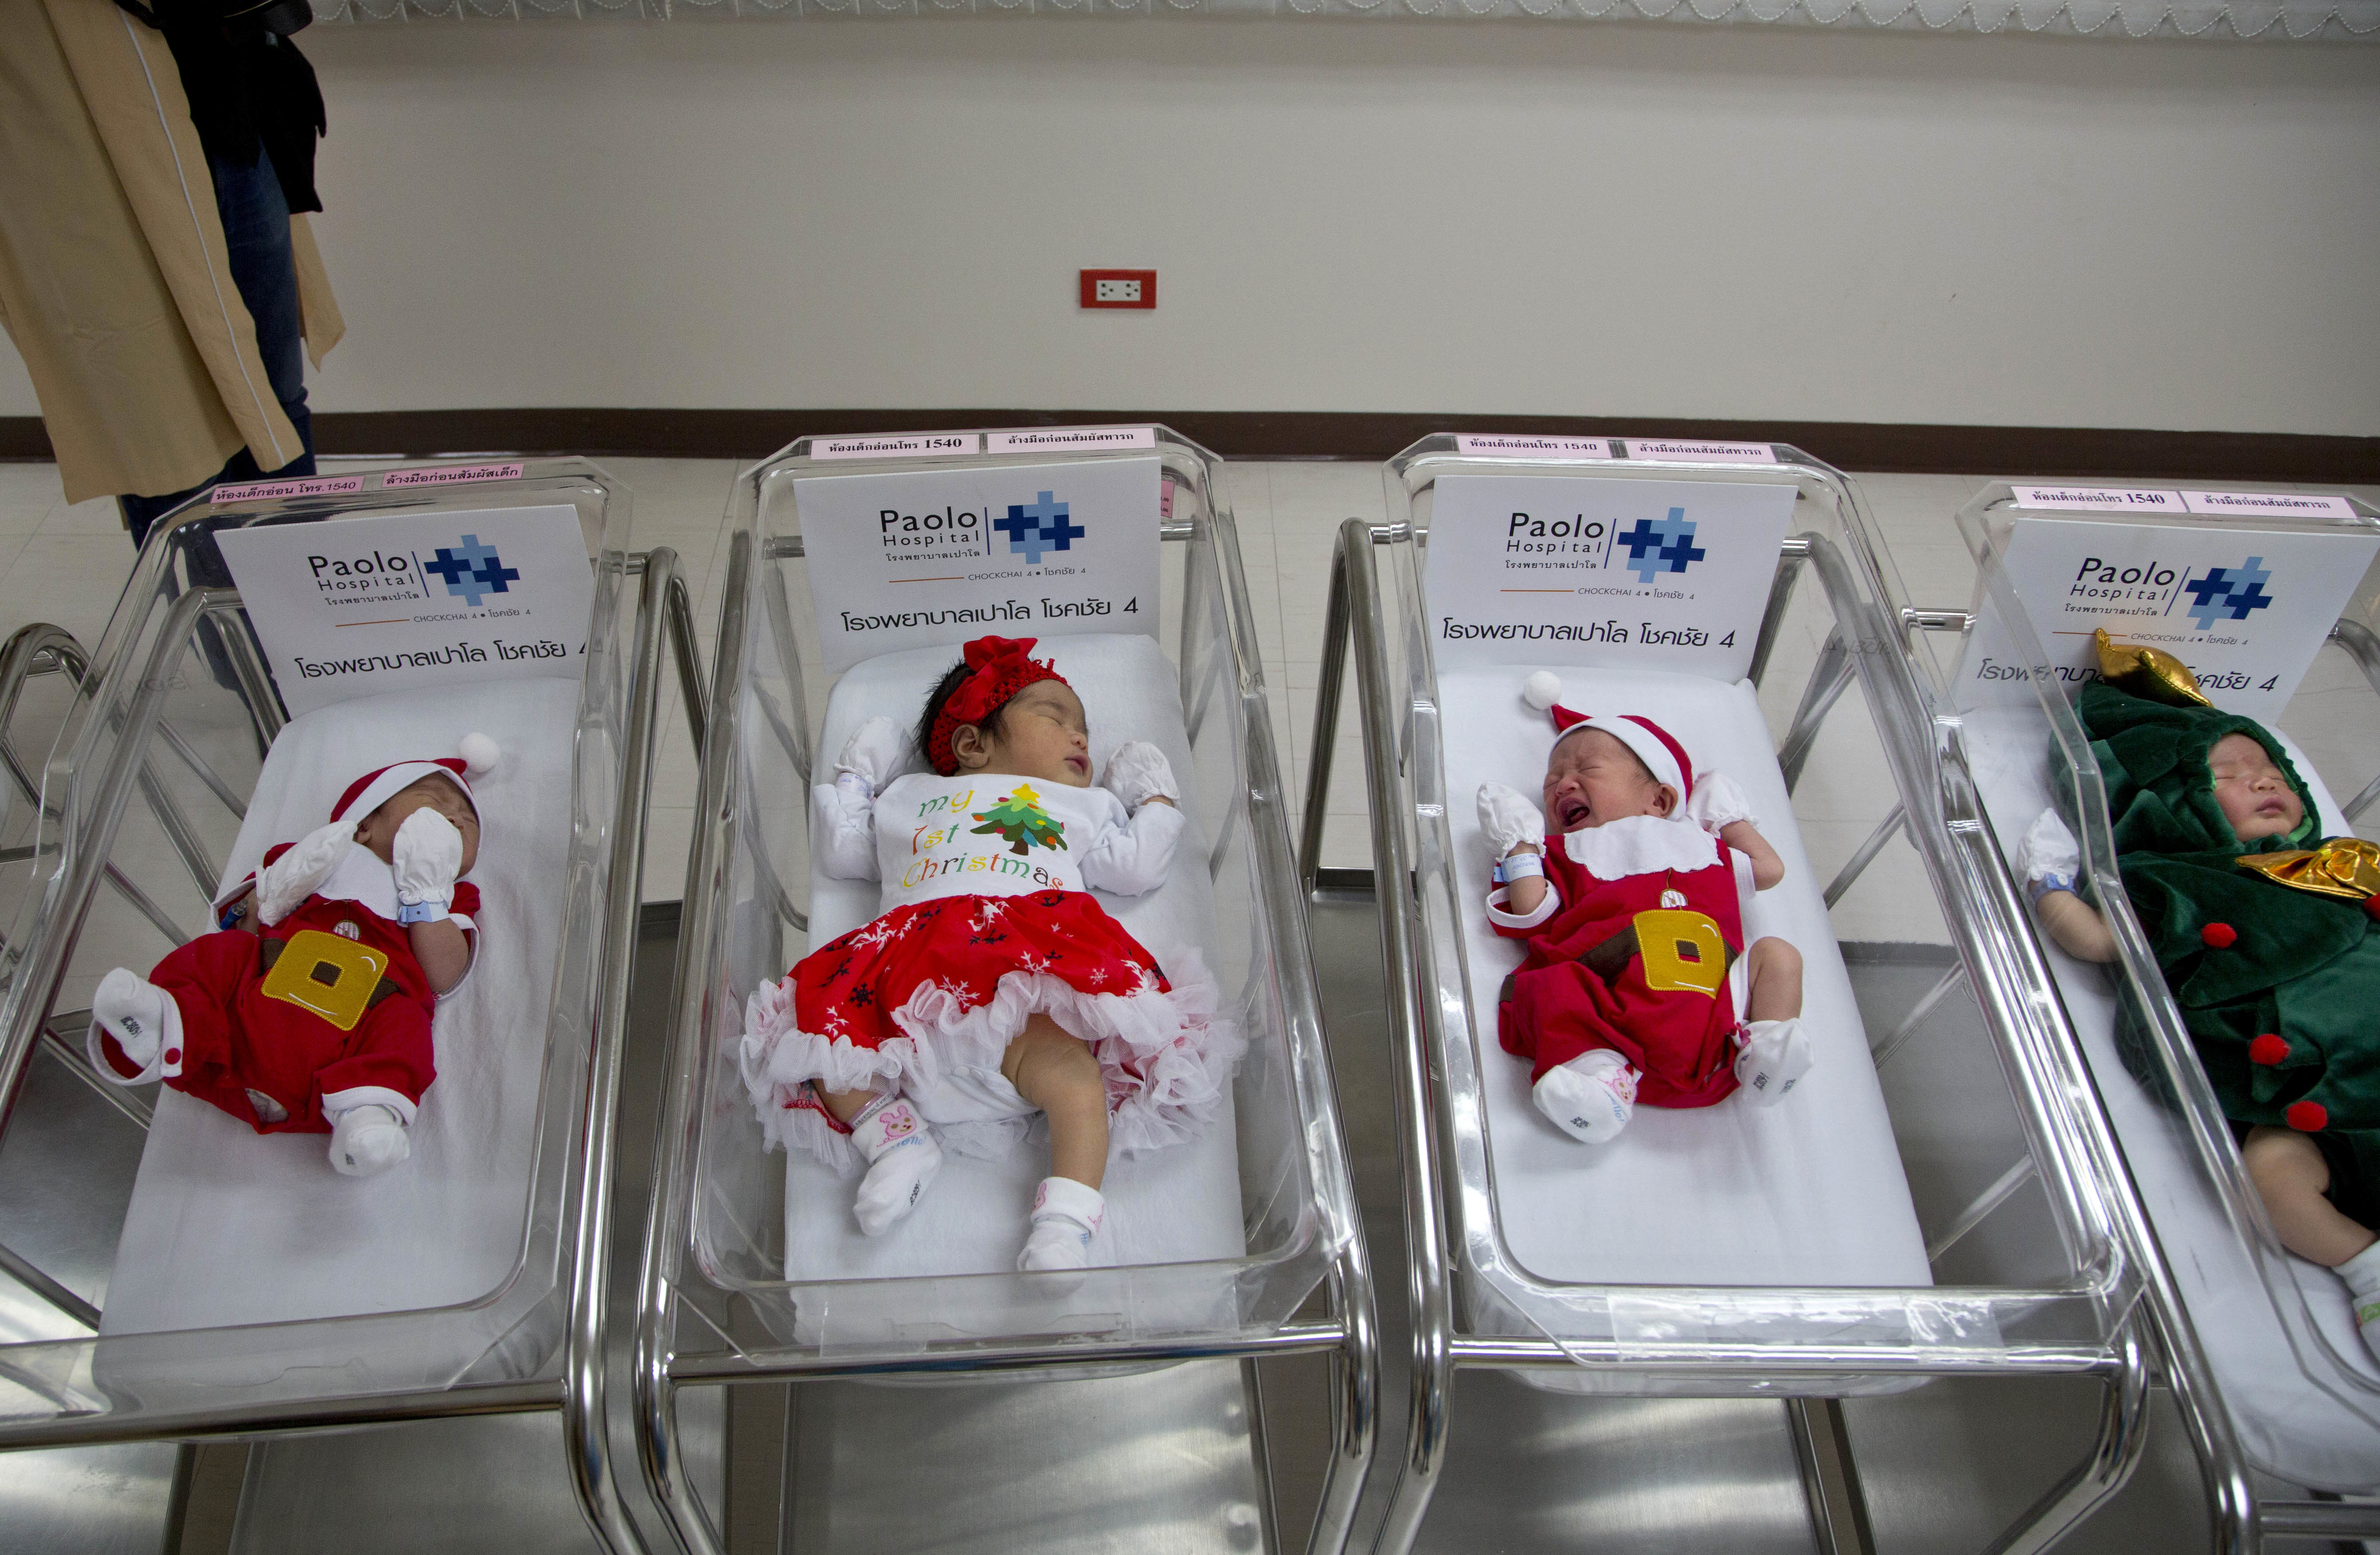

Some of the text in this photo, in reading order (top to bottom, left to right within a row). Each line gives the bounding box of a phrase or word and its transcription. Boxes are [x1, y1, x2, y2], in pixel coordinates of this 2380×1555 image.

[926, 439, 962, 448] 1540
[386, 466, 519, 485] ล้างมือก่อนสัมผัสเด็ก
[2126, 493, 2165, 504] 1540
[880, 506, 978, 533] Paolo
[1509, 513, 1604, 538] Paolo
[883, 530, 978, 548] Hospital
[1507, 540, 1601, 556] Hospital
[308, 550, 408, 579] Paolo
[886, 549, 980, 562] โรงพยาบาลเปาโล
[1505, 560, 1596, 569] โรงพยาบาลเปาโล
[968, 571, 1022, 581] CHOCKCHAI
[1044, 567, 1075, 576] โชคชัย
[2076, 558, 2175, 586] Paolo
[318, 573, 415, 591] Hospital
[325, 591, 420, 605] โรงพยาบาลเปาโล
[1578, 588, 1632, 596] CHOCKCHAI
[1654, 588, 1684, 599] โชคชัย
[2070, 583, 2170, 601] Hospital
[413, 613, 467, 622] CHOCKCHAI
[487, 609, 520, 617] โชคชัย
[840, 596, 1138, 632] โรงพยาบาลเปาโล โชคชัย 4
[2065, 603, 2158, 616] โรงพยาบาลเปาโล
[1443, 617, 1735, 648] โรงพยาบาลเปาโล โชคชัย 4
[2131, 633, 2186, 642] CHOCKCHAI
[2206, 634, 2238, 645] โชคชัย
[294, 642, 487, 678] โรงพยาบาลเปาโล
[493, 640, 566, 660] โชคชัย
[2258, 674, 2279, 692] 4
[918, 790, 974, 817] my
[912, 823, 959, 855] 1st
[903, 851, 1064, 891] Christmas
